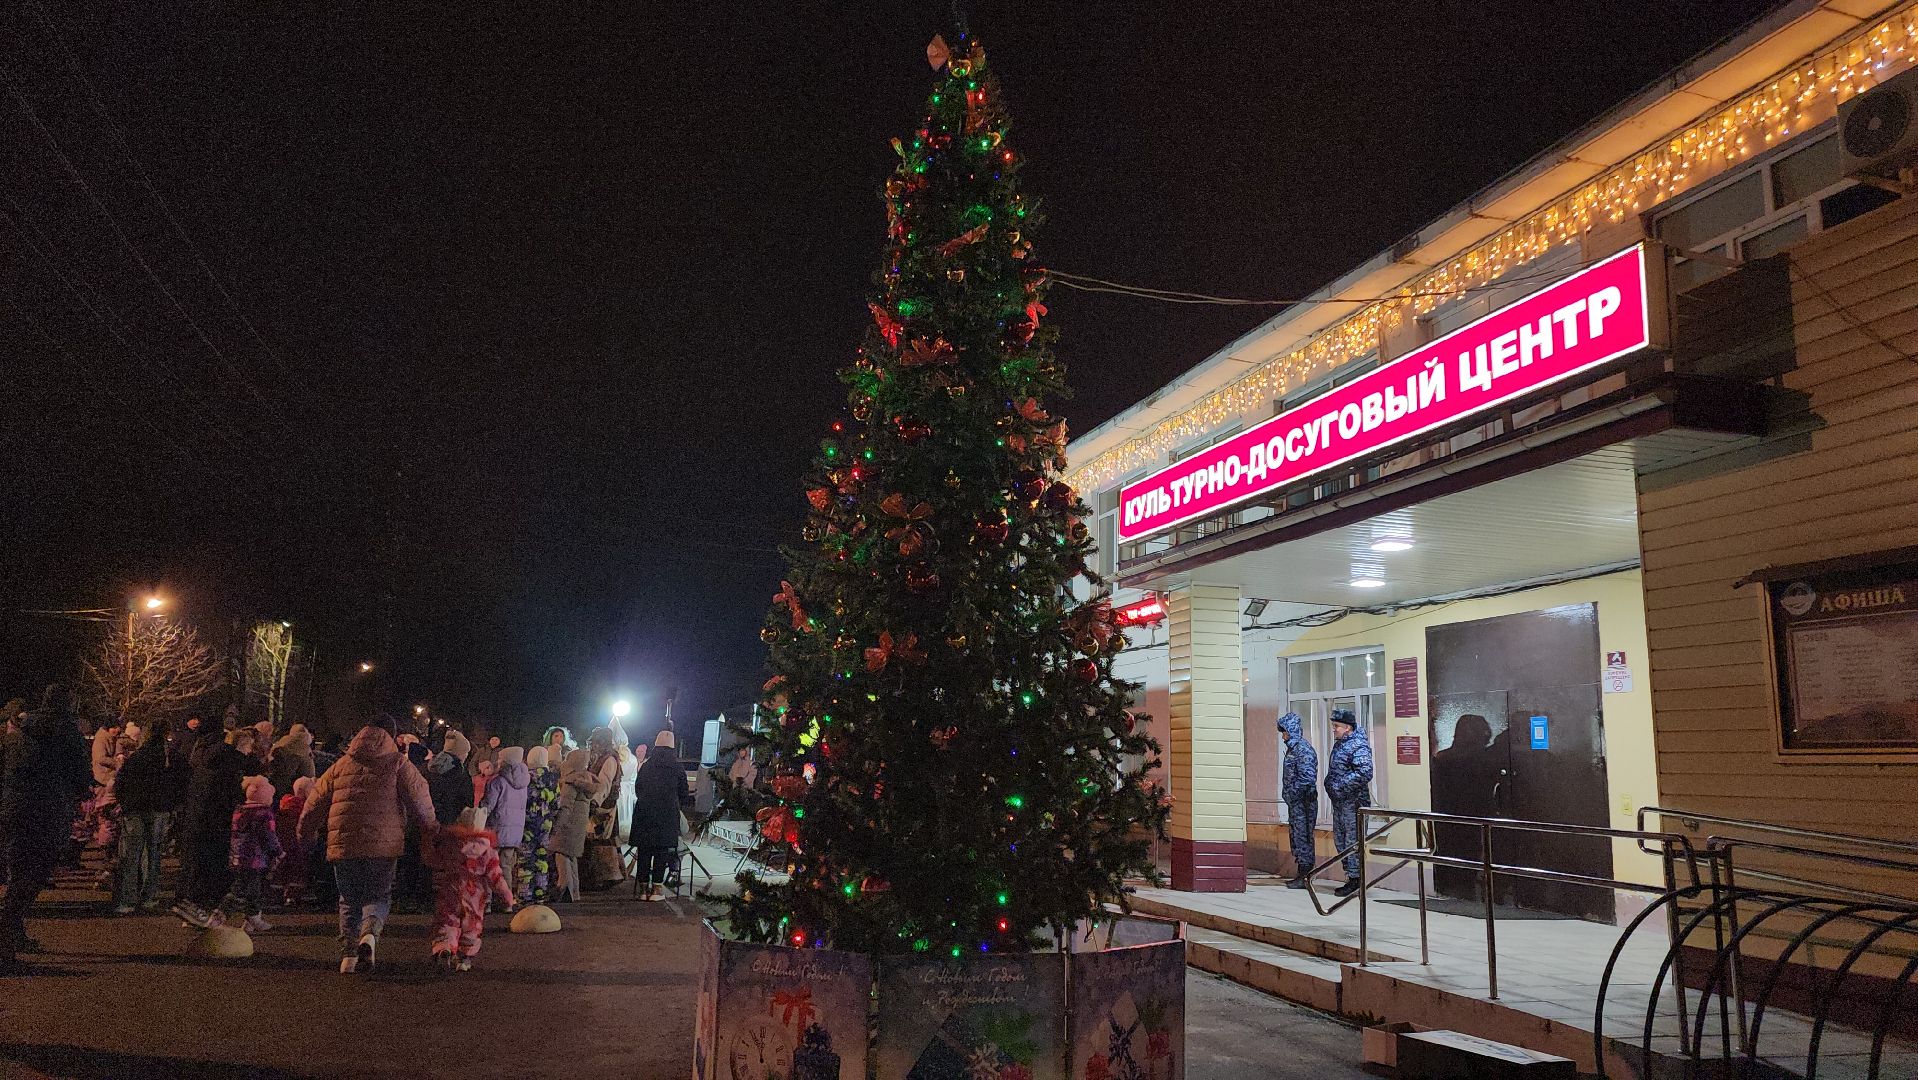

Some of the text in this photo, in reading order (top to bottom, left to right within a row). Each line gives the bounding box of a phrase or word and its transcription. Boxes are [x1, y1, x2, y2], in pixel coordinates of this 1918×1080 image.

[1124, 285, 1622, 527] КУЛЬТУРНО-ДОСУГОВЫЙ ЦЕНТР
[1820, 587, 1906, 612] АФИША
